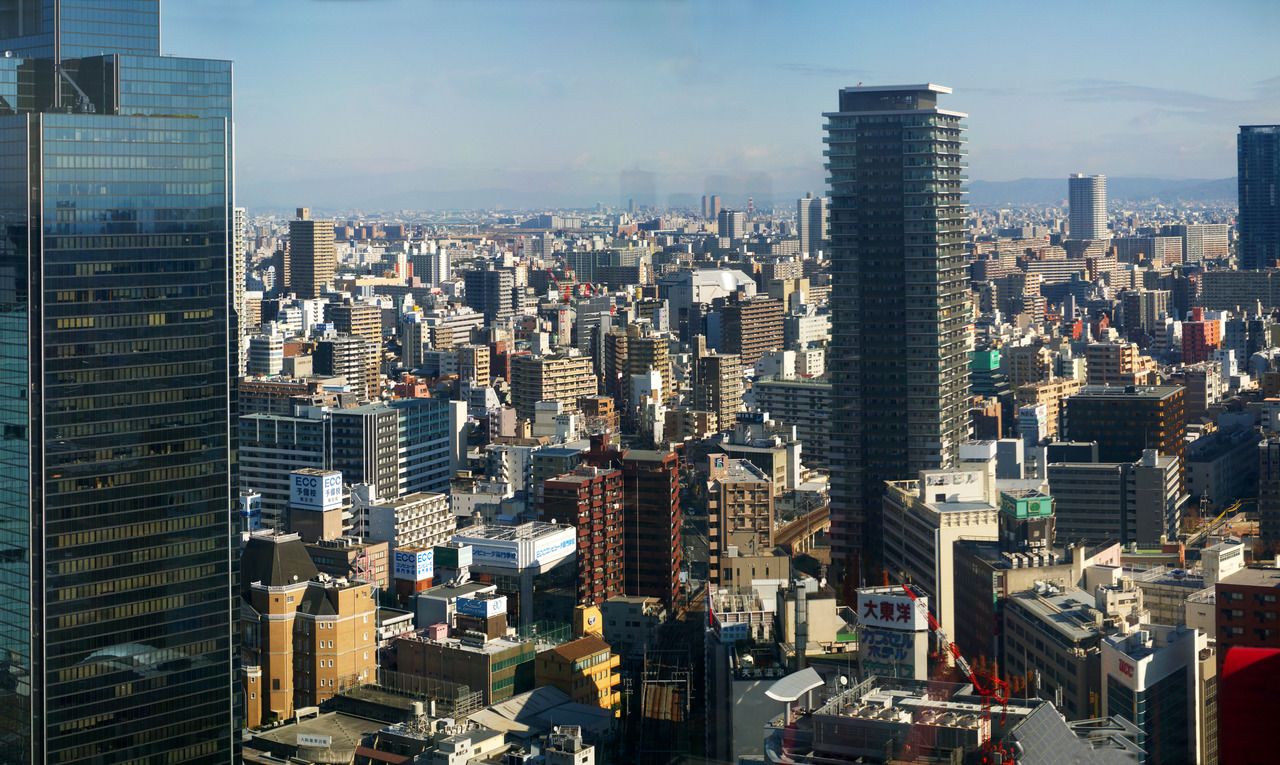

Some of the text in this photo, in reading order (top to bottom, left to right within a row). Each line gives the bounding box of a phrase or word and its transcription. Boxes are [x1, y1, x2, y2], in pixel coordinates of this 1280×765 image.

[295, 476, 317, 487] ECC
[325, 476, 341, 488] ECC
[395, 553, 416, 563] ECC
[417, 551, 433, 563] ECC
[863, 600, 911, 624] 大東洋
